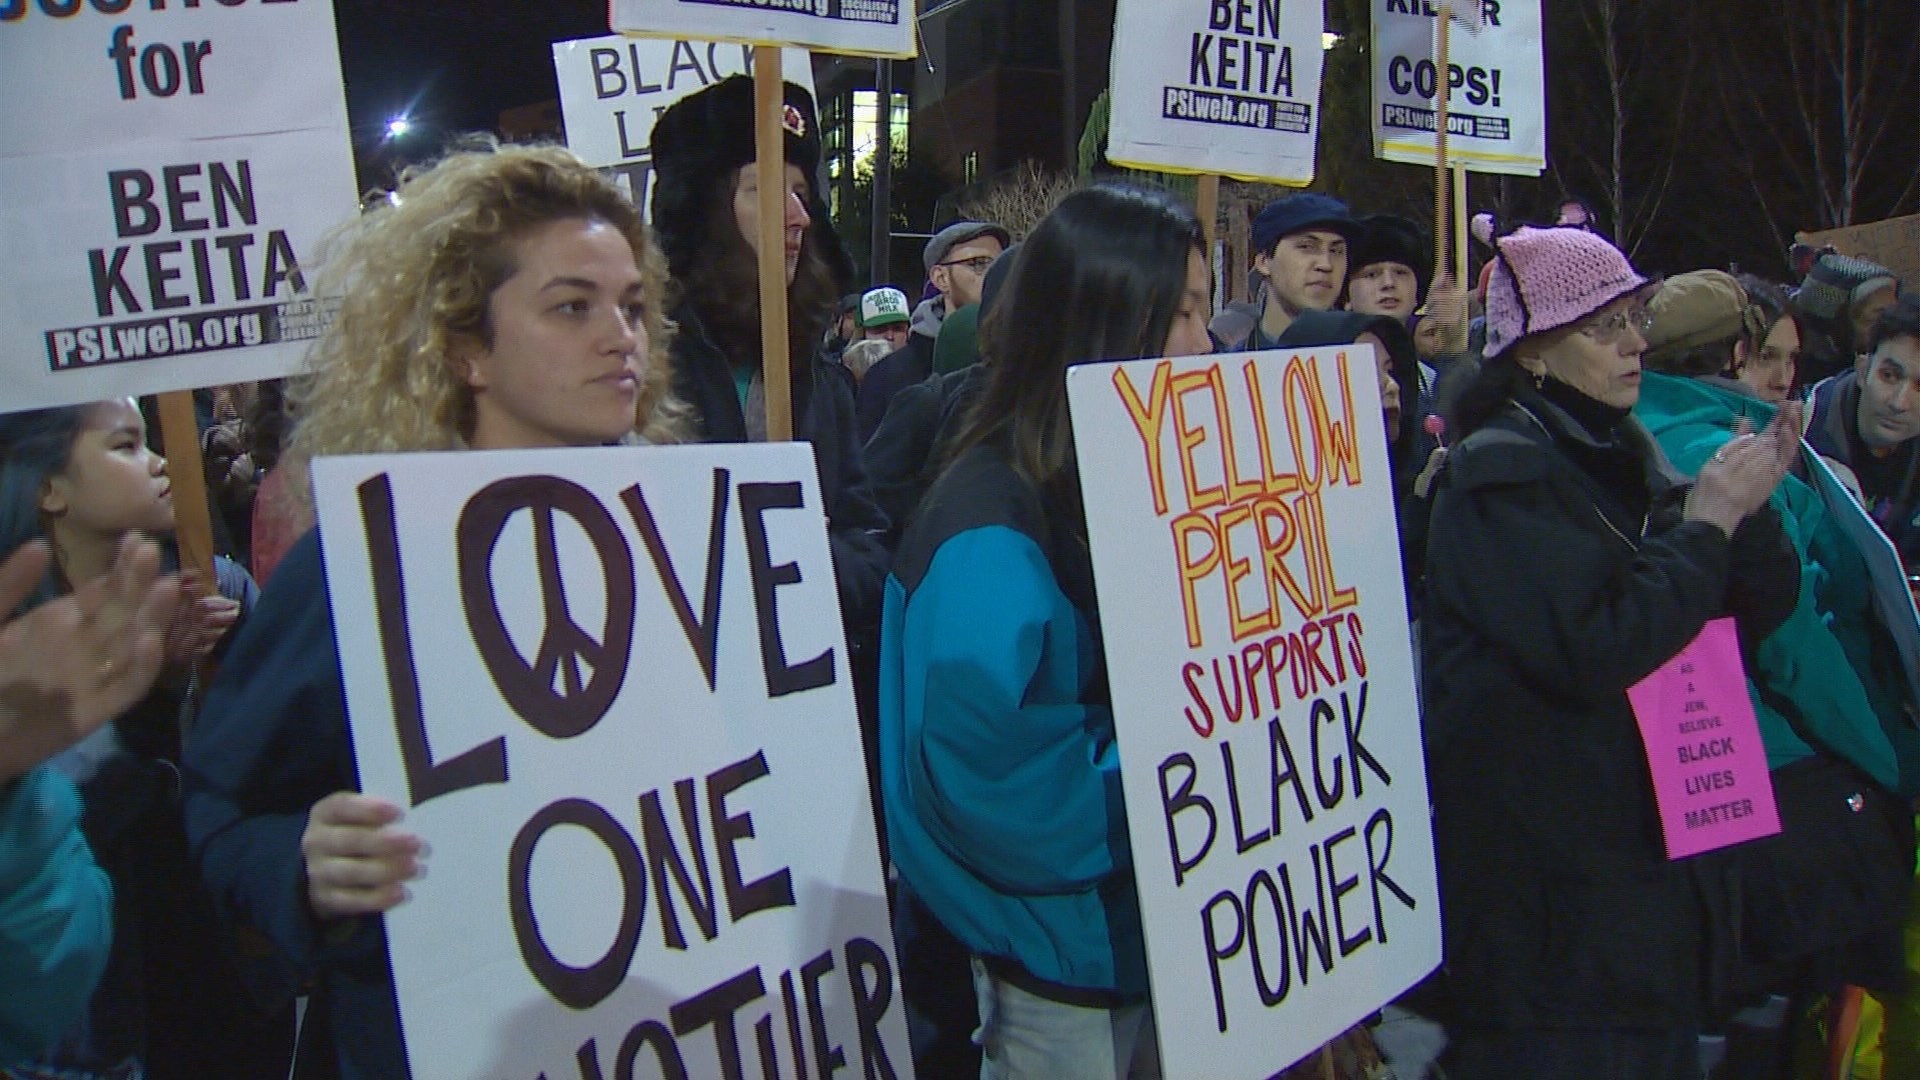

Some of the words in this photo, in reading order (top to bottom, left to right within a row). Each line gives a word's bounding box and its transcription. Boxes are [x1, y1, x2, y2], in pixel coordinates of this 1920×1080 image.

[1209, 0, 1281, 39] BEN
[108, 24, 212, 100] for
[1190, 32, 1293, 97] KEITA
[1388, 55, 1501, 107] COPS!
[1166, 88, 1269, 128] PSLweb.org
[1384, 105, 1474, 136] PSLweorg
[107, 159, 258, 238] BEN
[88, 229, 308, 318] KEITA
[53, 312, 263, 368] PSLweb.org
[1113, 351, 1361, 516] YELLOW
[1170, 487, 1358, 648] PERIL
[355, 467, 836, 808] LOVE
[1181, 612, 1368, 738] SUPPORTS
[1157, 680, 1391, 887] BLACK
[1677, 736, 1735, 764] BLACK
[1684, 769, 1736, 796] LIVES
[1683, 799, 1753, 830] MATTER
[508, 749, 796, 1009] ONE
[1200, 806, 1416, 1033] POWER
[534, 937, 908, 1080] THER
